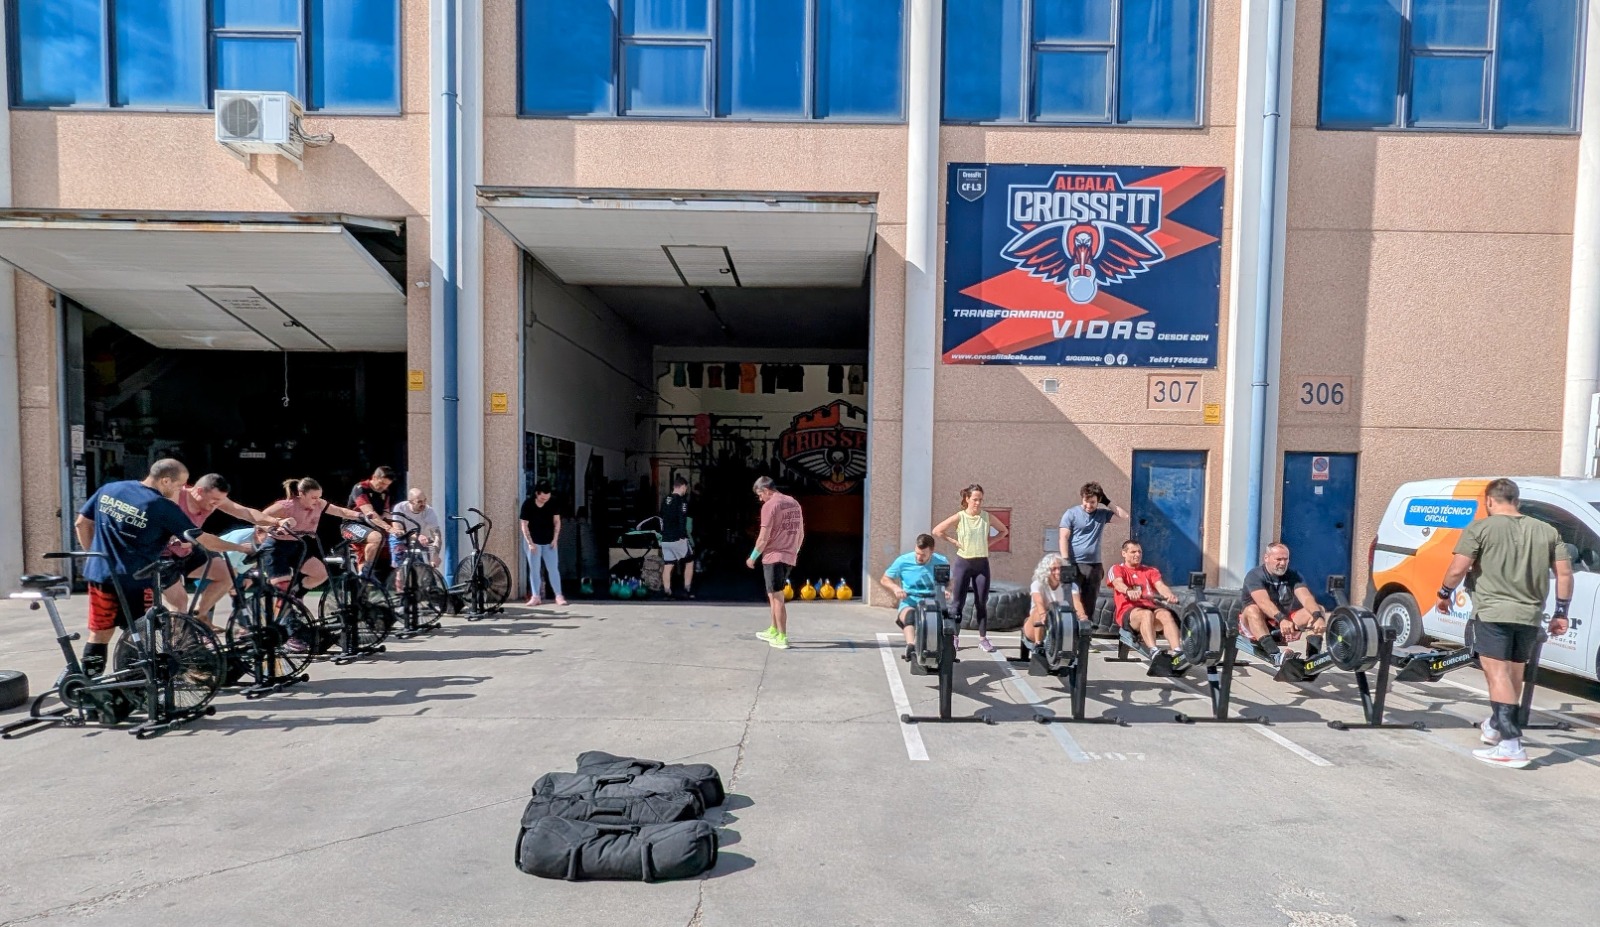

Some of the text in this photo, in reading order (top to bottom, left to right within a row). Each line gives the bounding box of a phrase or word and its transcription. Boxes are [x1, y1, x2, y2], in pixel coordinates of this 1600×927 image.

[1055, 176, 1116, 191] ALCALA
[1013, 191, 1156, 224] CROSSFIT
[953, 309, 1065, 319] TRANSFORMANDO
[1051, 320, 1156, 340] VIDAS
[1157, 333, 1189, 341] DESDE
[1153, 380, 1198, 404] 307
[1301, 382, 1344, 405] 306
[99, 494, 148, 522] BARBELL
[1409, 505, 1473, 516] SERVICIO TÉCNICO
[125, 515, 147, 529] Club
[1424, 514, 1448, 523] OFICIAL
